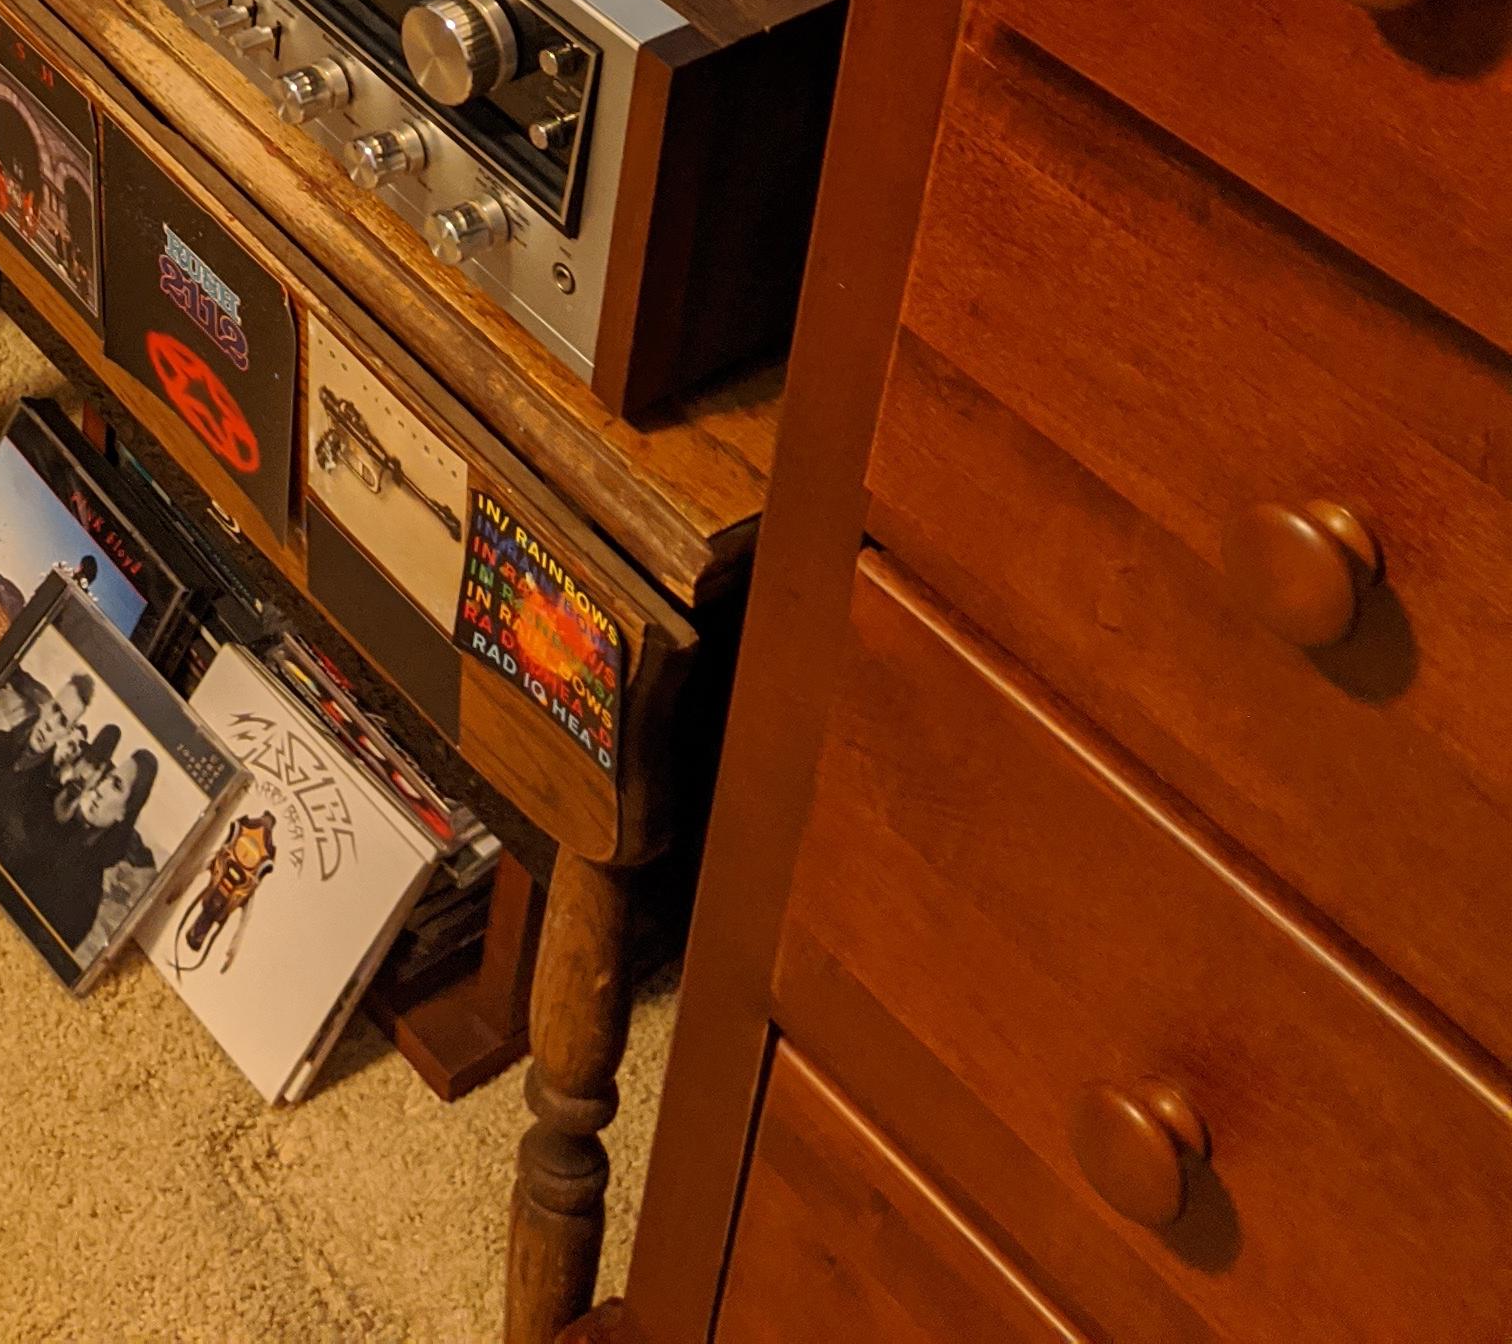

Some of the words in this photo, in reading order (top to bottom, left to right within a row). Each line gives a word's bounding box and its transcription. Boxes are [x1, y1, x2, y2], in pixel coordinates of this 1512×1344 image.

[158, 254, 249, 372] 2112
[466, 580, 492, 610] IN
[515, 527, 619, 648] RAINBOWS
